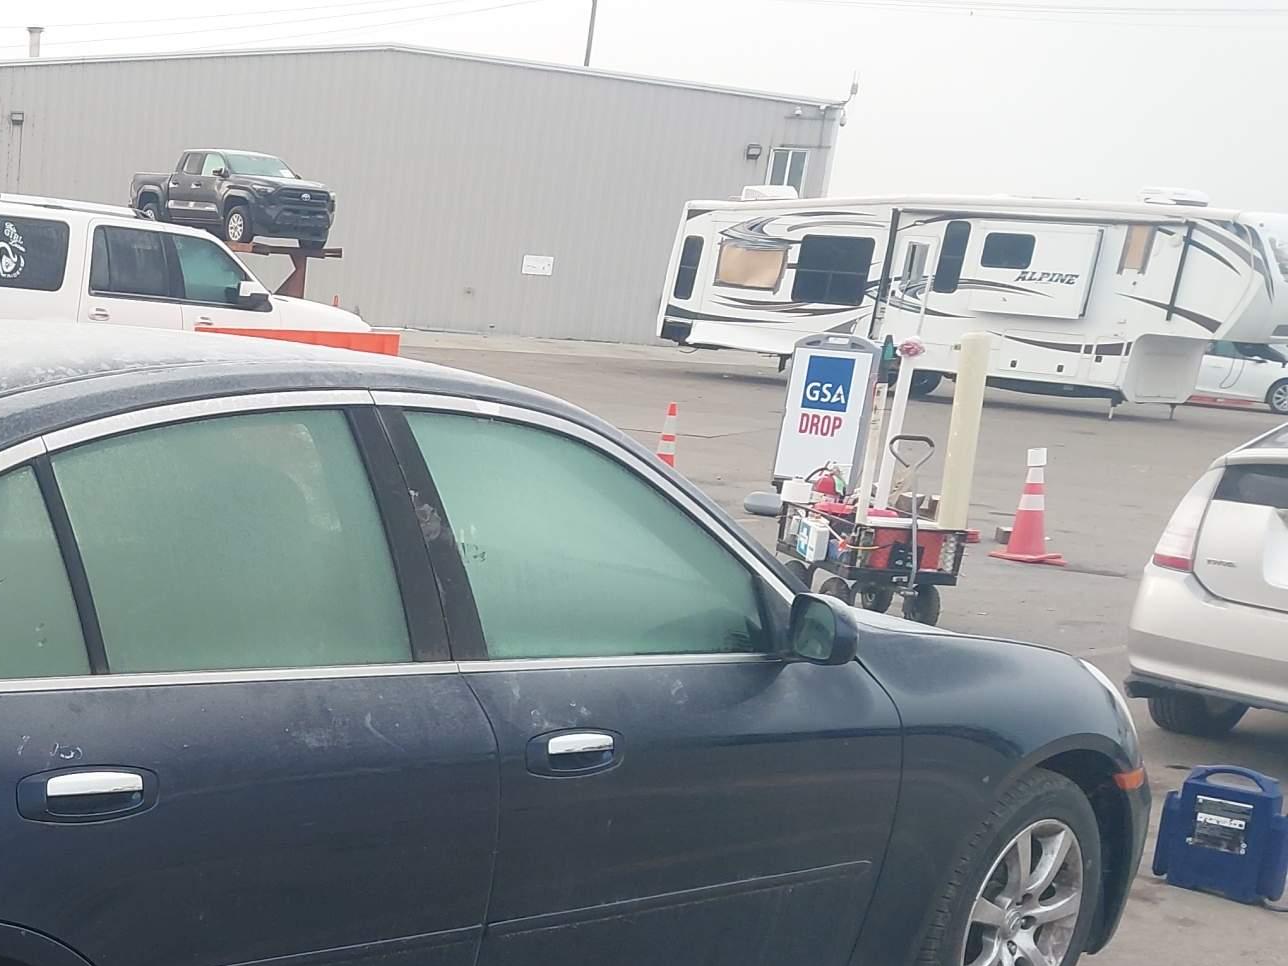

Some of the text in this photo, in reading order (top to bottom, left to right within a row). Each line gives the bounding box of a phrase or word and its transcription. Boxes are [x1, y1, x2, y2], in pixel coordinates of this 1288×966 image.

[1014, 270, 1080, 285] ALPINE
[806, 382, 846, 404] GSA
[798, 412, 843, 437] DROP
